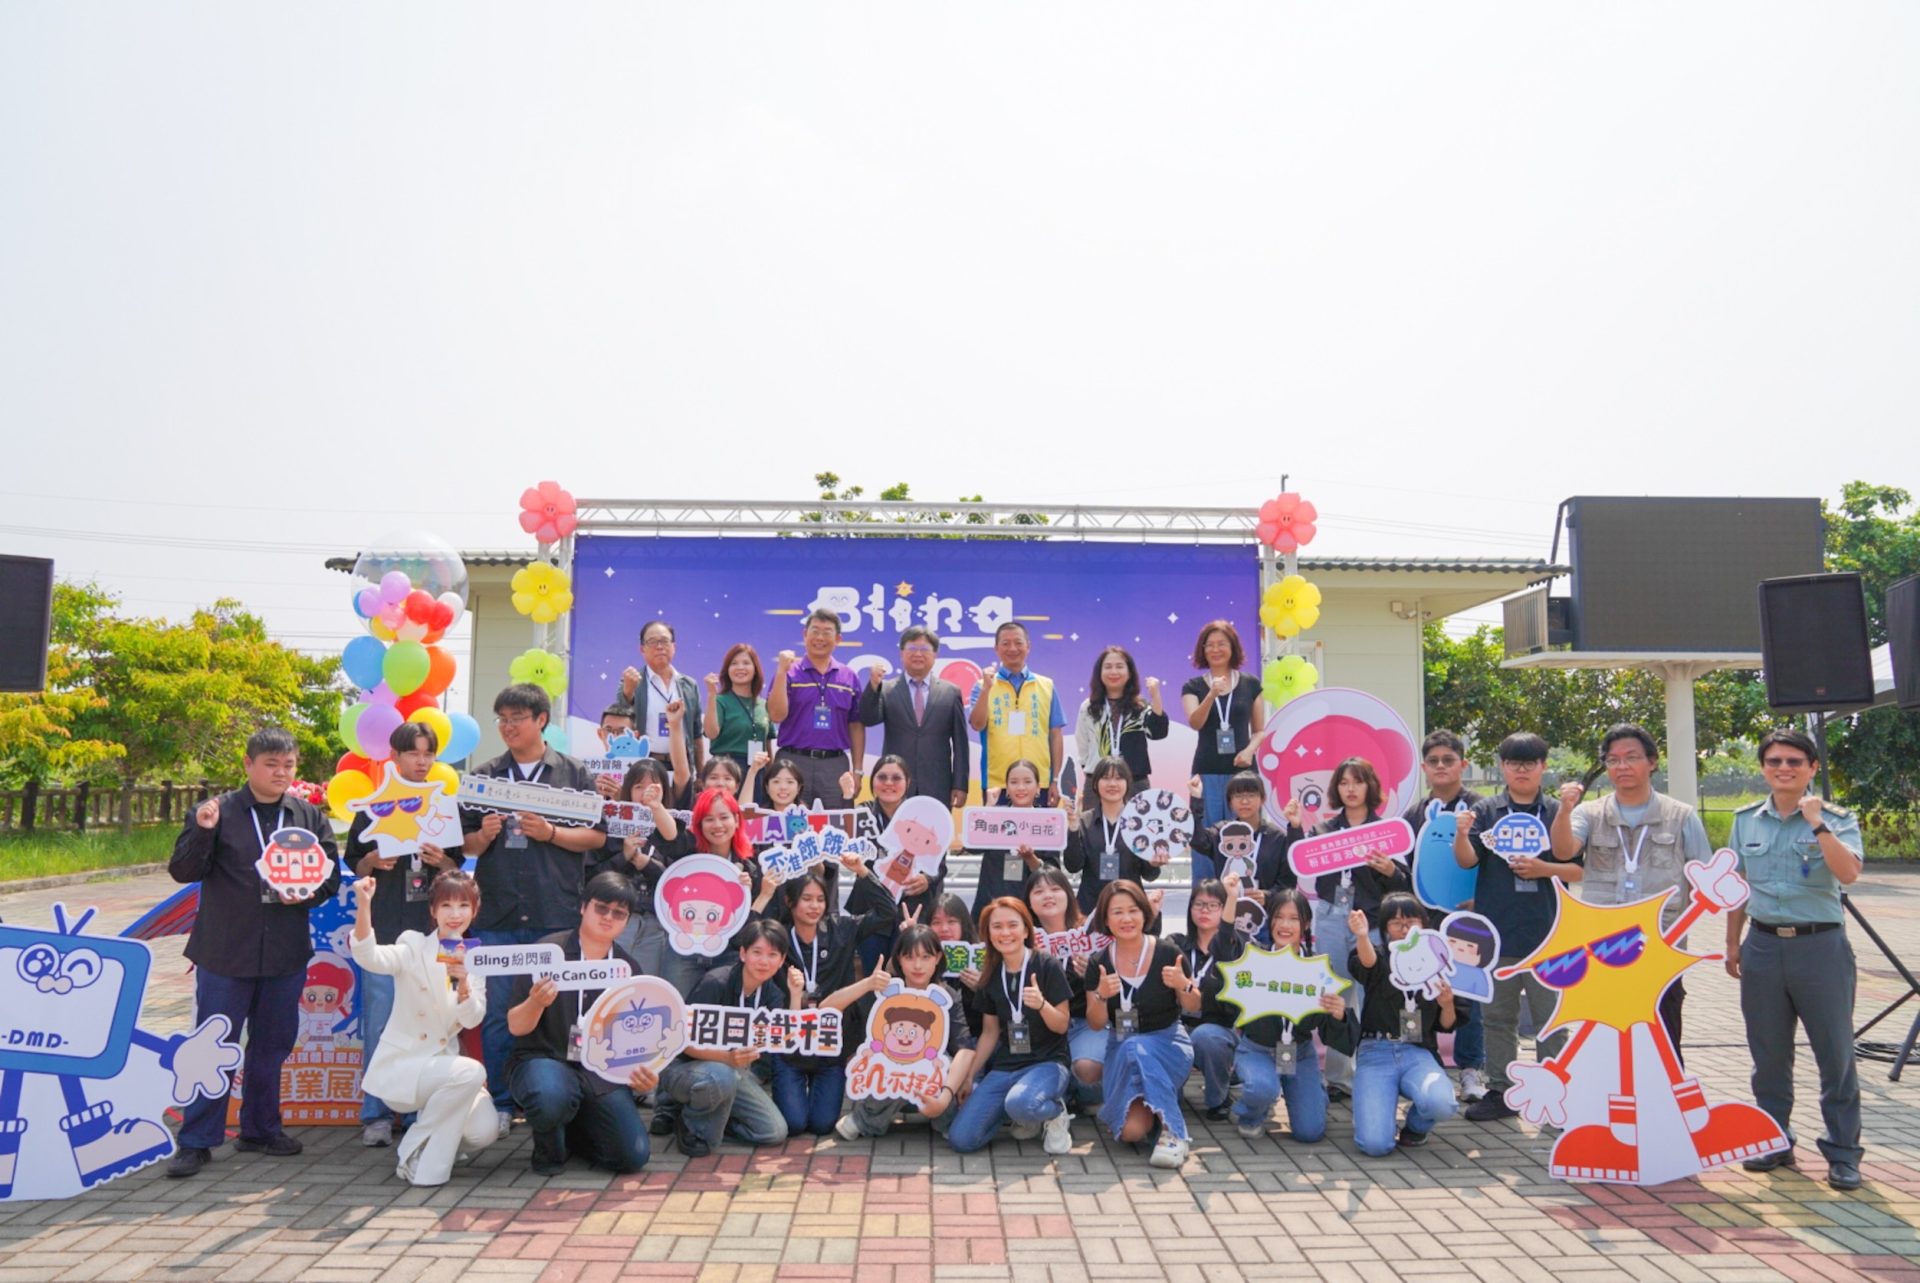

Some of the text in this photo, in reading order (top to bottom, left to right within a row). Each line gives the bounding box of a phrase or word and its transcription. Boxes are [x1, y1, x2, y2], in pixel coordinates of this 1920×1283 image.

[473, 954, 510, 967] Bling
[562, 970, 587, 981] Can
[589, 969, 607, 980] Go
